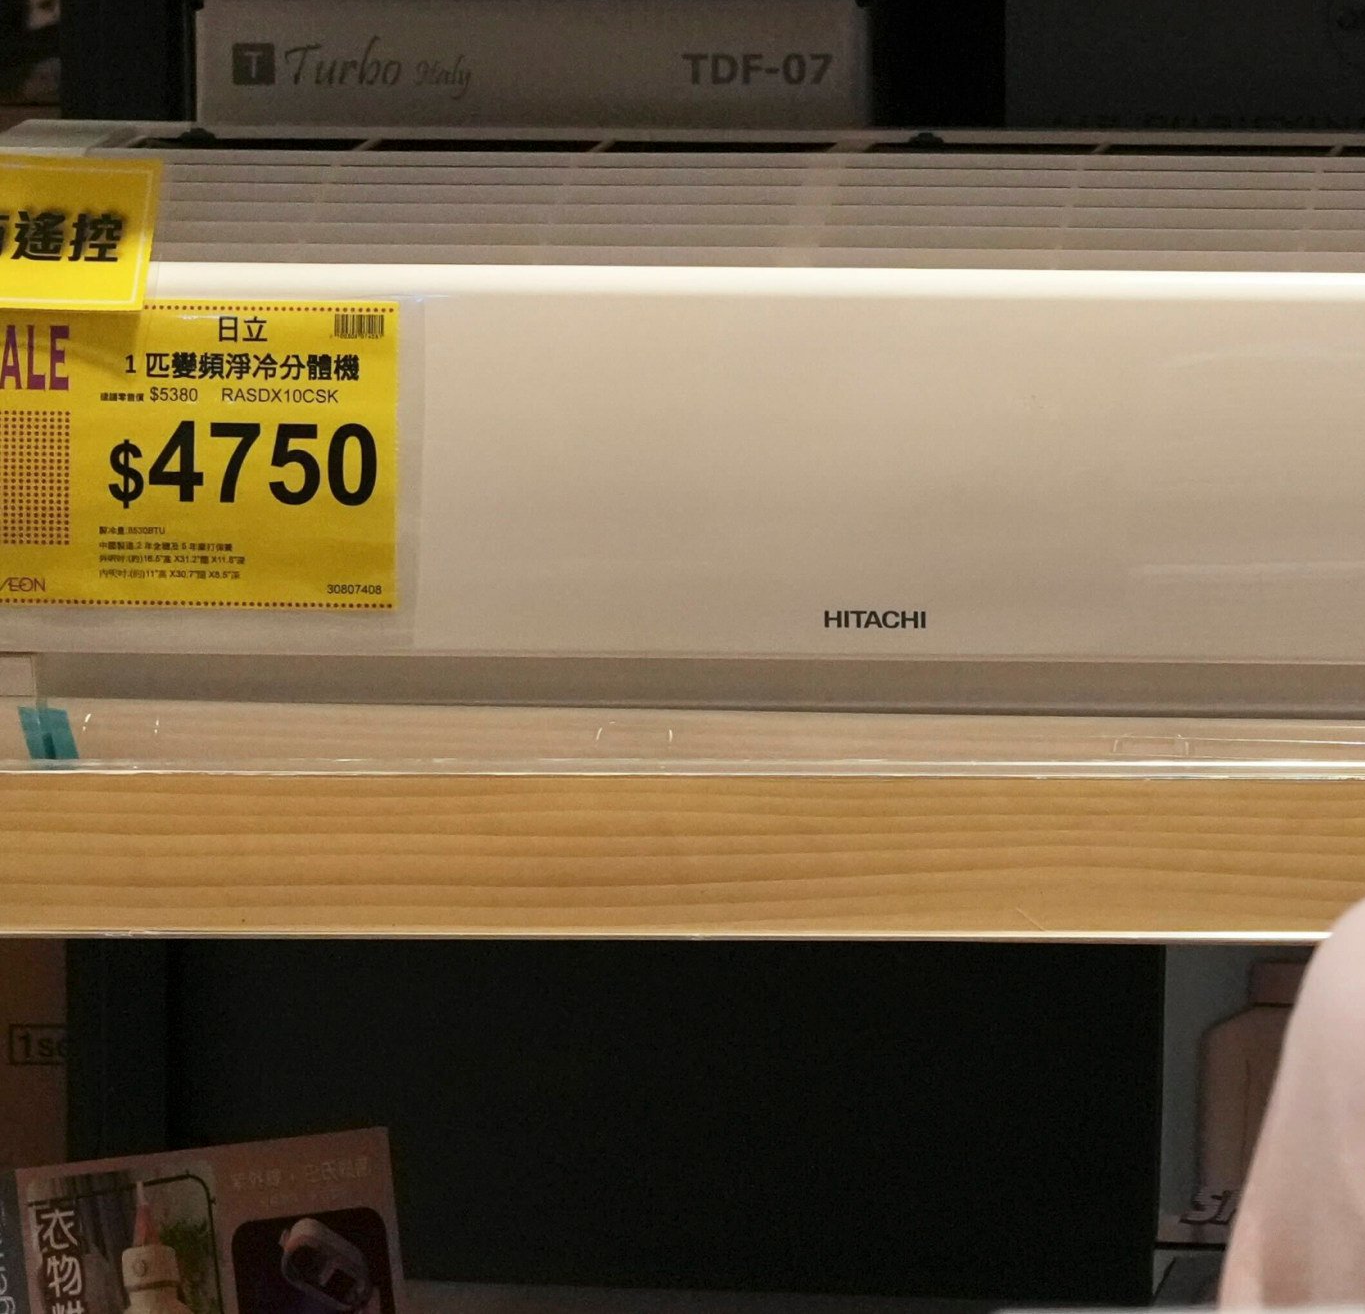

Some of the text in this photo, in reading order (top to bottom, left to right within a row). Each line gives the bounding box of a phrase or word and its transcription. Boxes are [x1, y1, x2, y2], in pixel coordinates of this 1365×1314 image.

[284, 34, 400, 87] Turbo
[682, 51, 834, 86] TDF-07
[0, 211, 125, 263] 遙控
[217, 316, 268, 344] 日立
[0, 324, 70, 391] ALE
[125, 352, 360, 382] 1 匹變頻淨冷分體機
[150, 386, 339, 404] $5380 RASDX10CSK
[109, 419, 378, 509] $4750
[327, 583, 382, 595] 30807408
[824, 610, 926, 628] HITACHI
